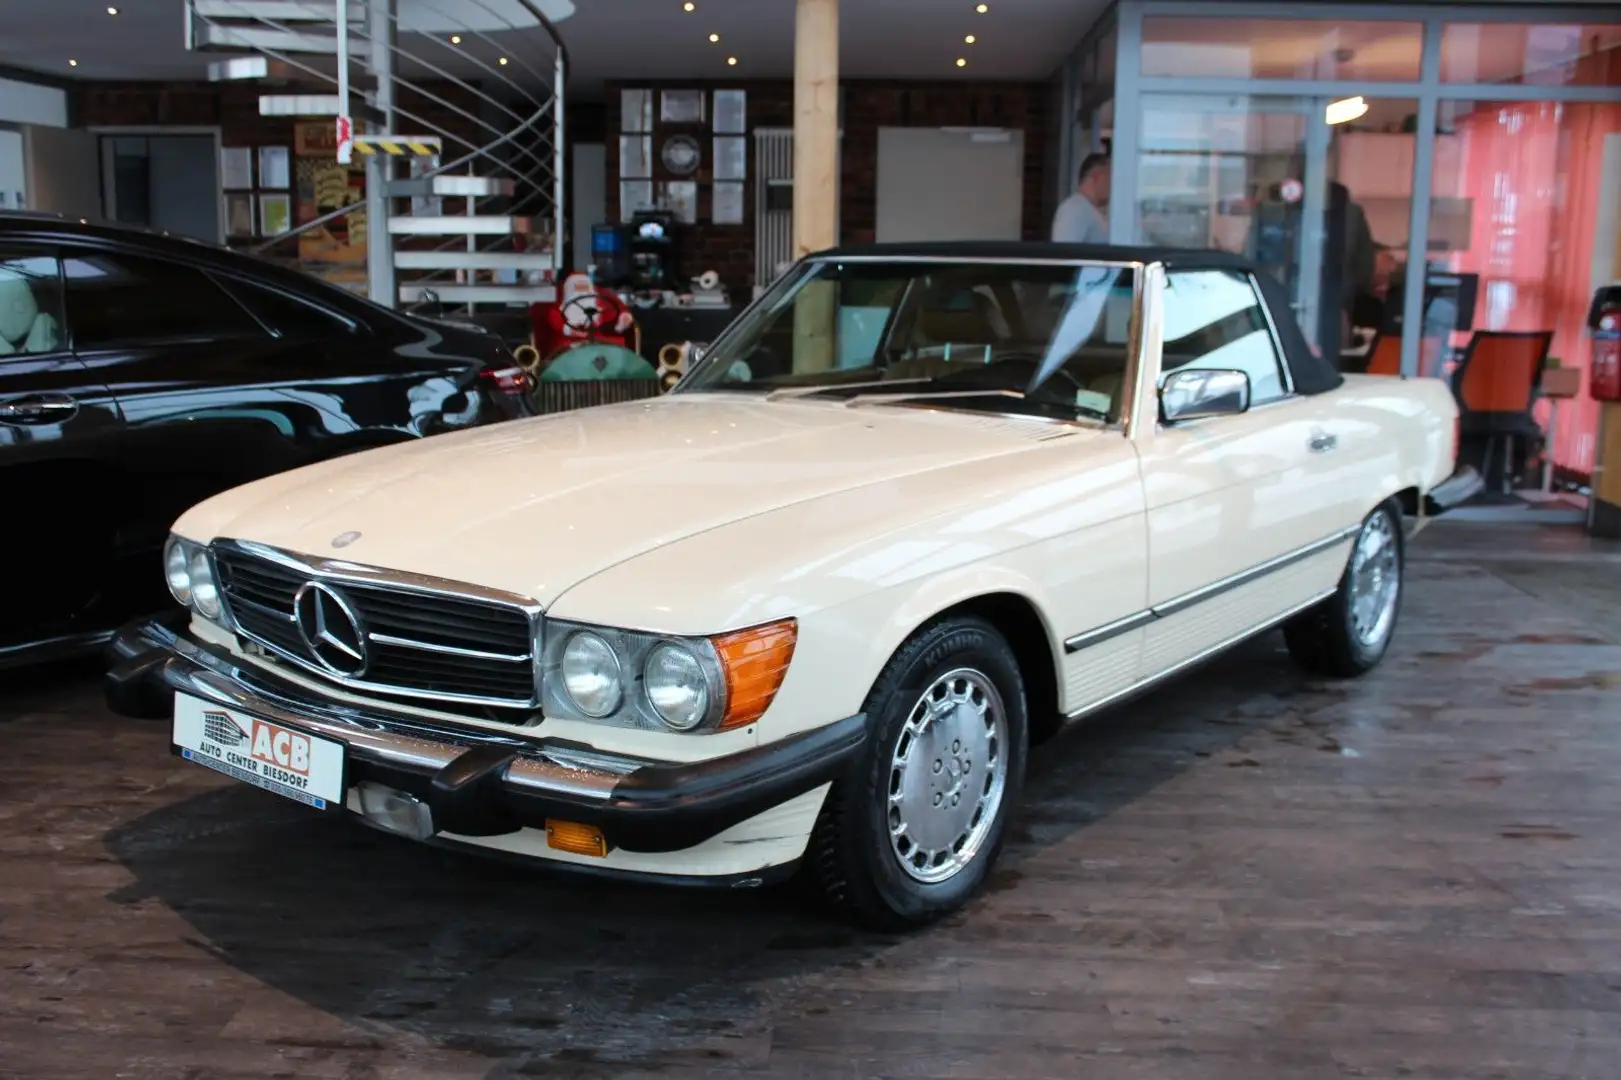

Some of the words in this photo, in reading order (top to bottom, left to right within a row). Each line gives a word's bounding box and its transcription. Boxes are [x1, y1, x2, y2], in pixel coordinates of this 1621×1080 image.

[200, 742, 221, 758] AUTO
[226, 753, 257, 772] CENTER
[263, 765, 308, 789] BIESDORF
[251, 724, 309, 772] ACB
